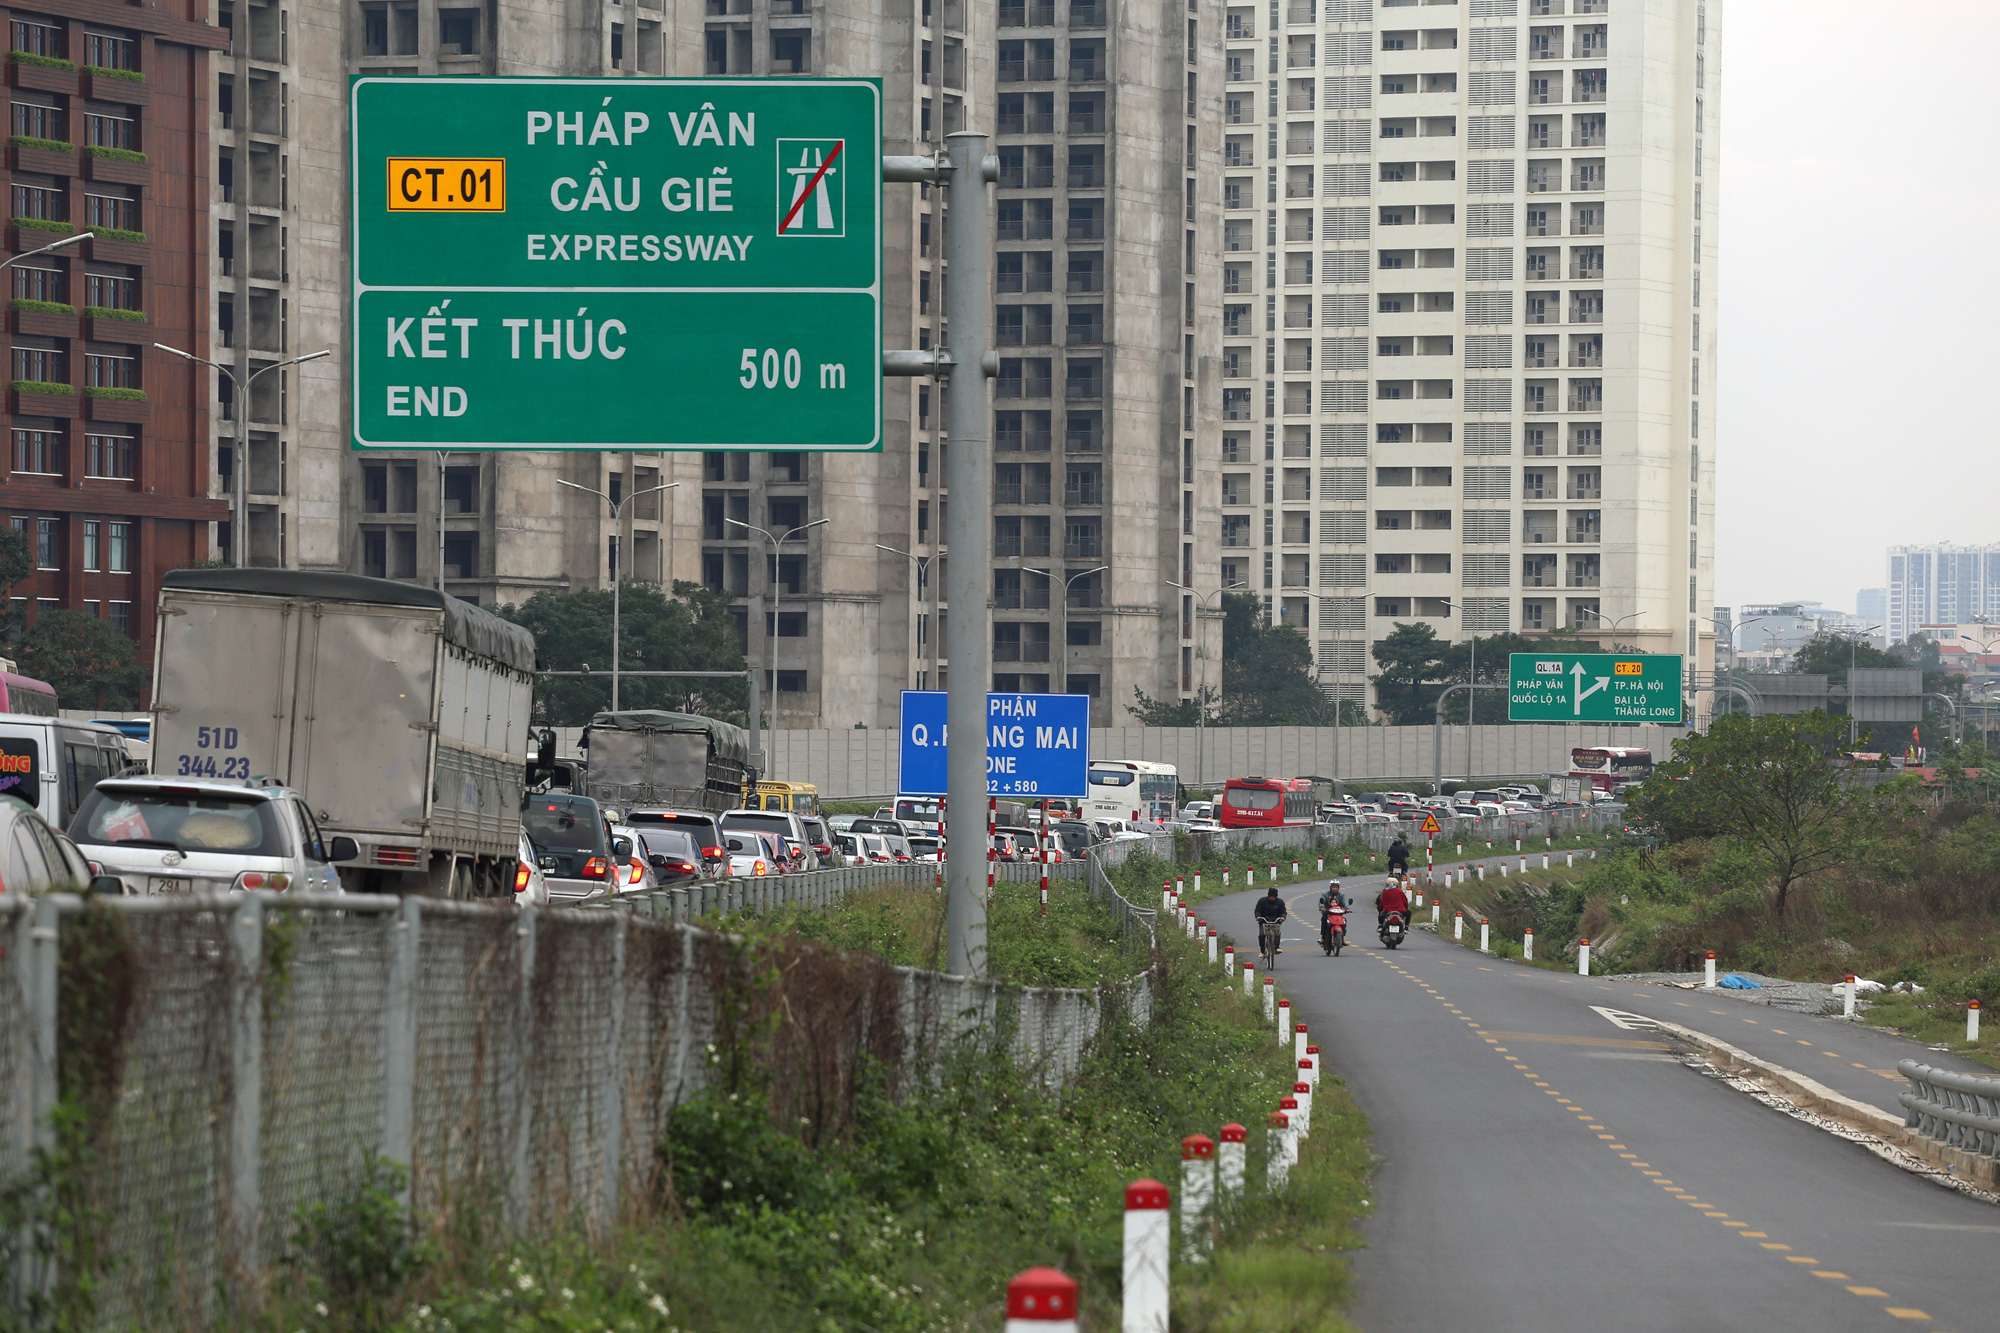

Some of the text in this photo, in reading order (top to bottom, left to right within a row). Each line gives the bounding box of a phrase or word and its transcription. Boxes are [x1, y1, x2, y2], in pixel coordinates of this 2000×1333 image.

[528, 97, 754, 146] PHÁP VÂN
[402, 168, 490, 202] CT.01
[551, 161, 733, 211] CẦU GIẼ
[528, 235, 753, 261] EXPRESSWAY
[388, 300, 626, 359] KẾT THÚC
[740, 348, 845, 388] 500 m
[388, 386, 467, 416] END
[1536, 663, 1561, 673] QL.1A
[1616, 664, 1641, 673] CT.20
[1517, 679, 1563, 688] PHÁP VÂN
[1615, 680, 1663, 692] TP.HÀ NỘI
[991, 695, 1037, 720] PHẬN
[1512, 692, 1537, 703] QUỐC
[1541, 693, 1552, 705] LỘ
[1615, 695, 1646, 707] ĐẠI LỘ
[1615, 705, 1674, 716] THĂNG LONG
[198, 727, 238, 749] 51D
[1036, 727, 1077, 749] MAI
[178, 755, 250, 780] 344.23
[1015, 781, 1037, 792] 580
